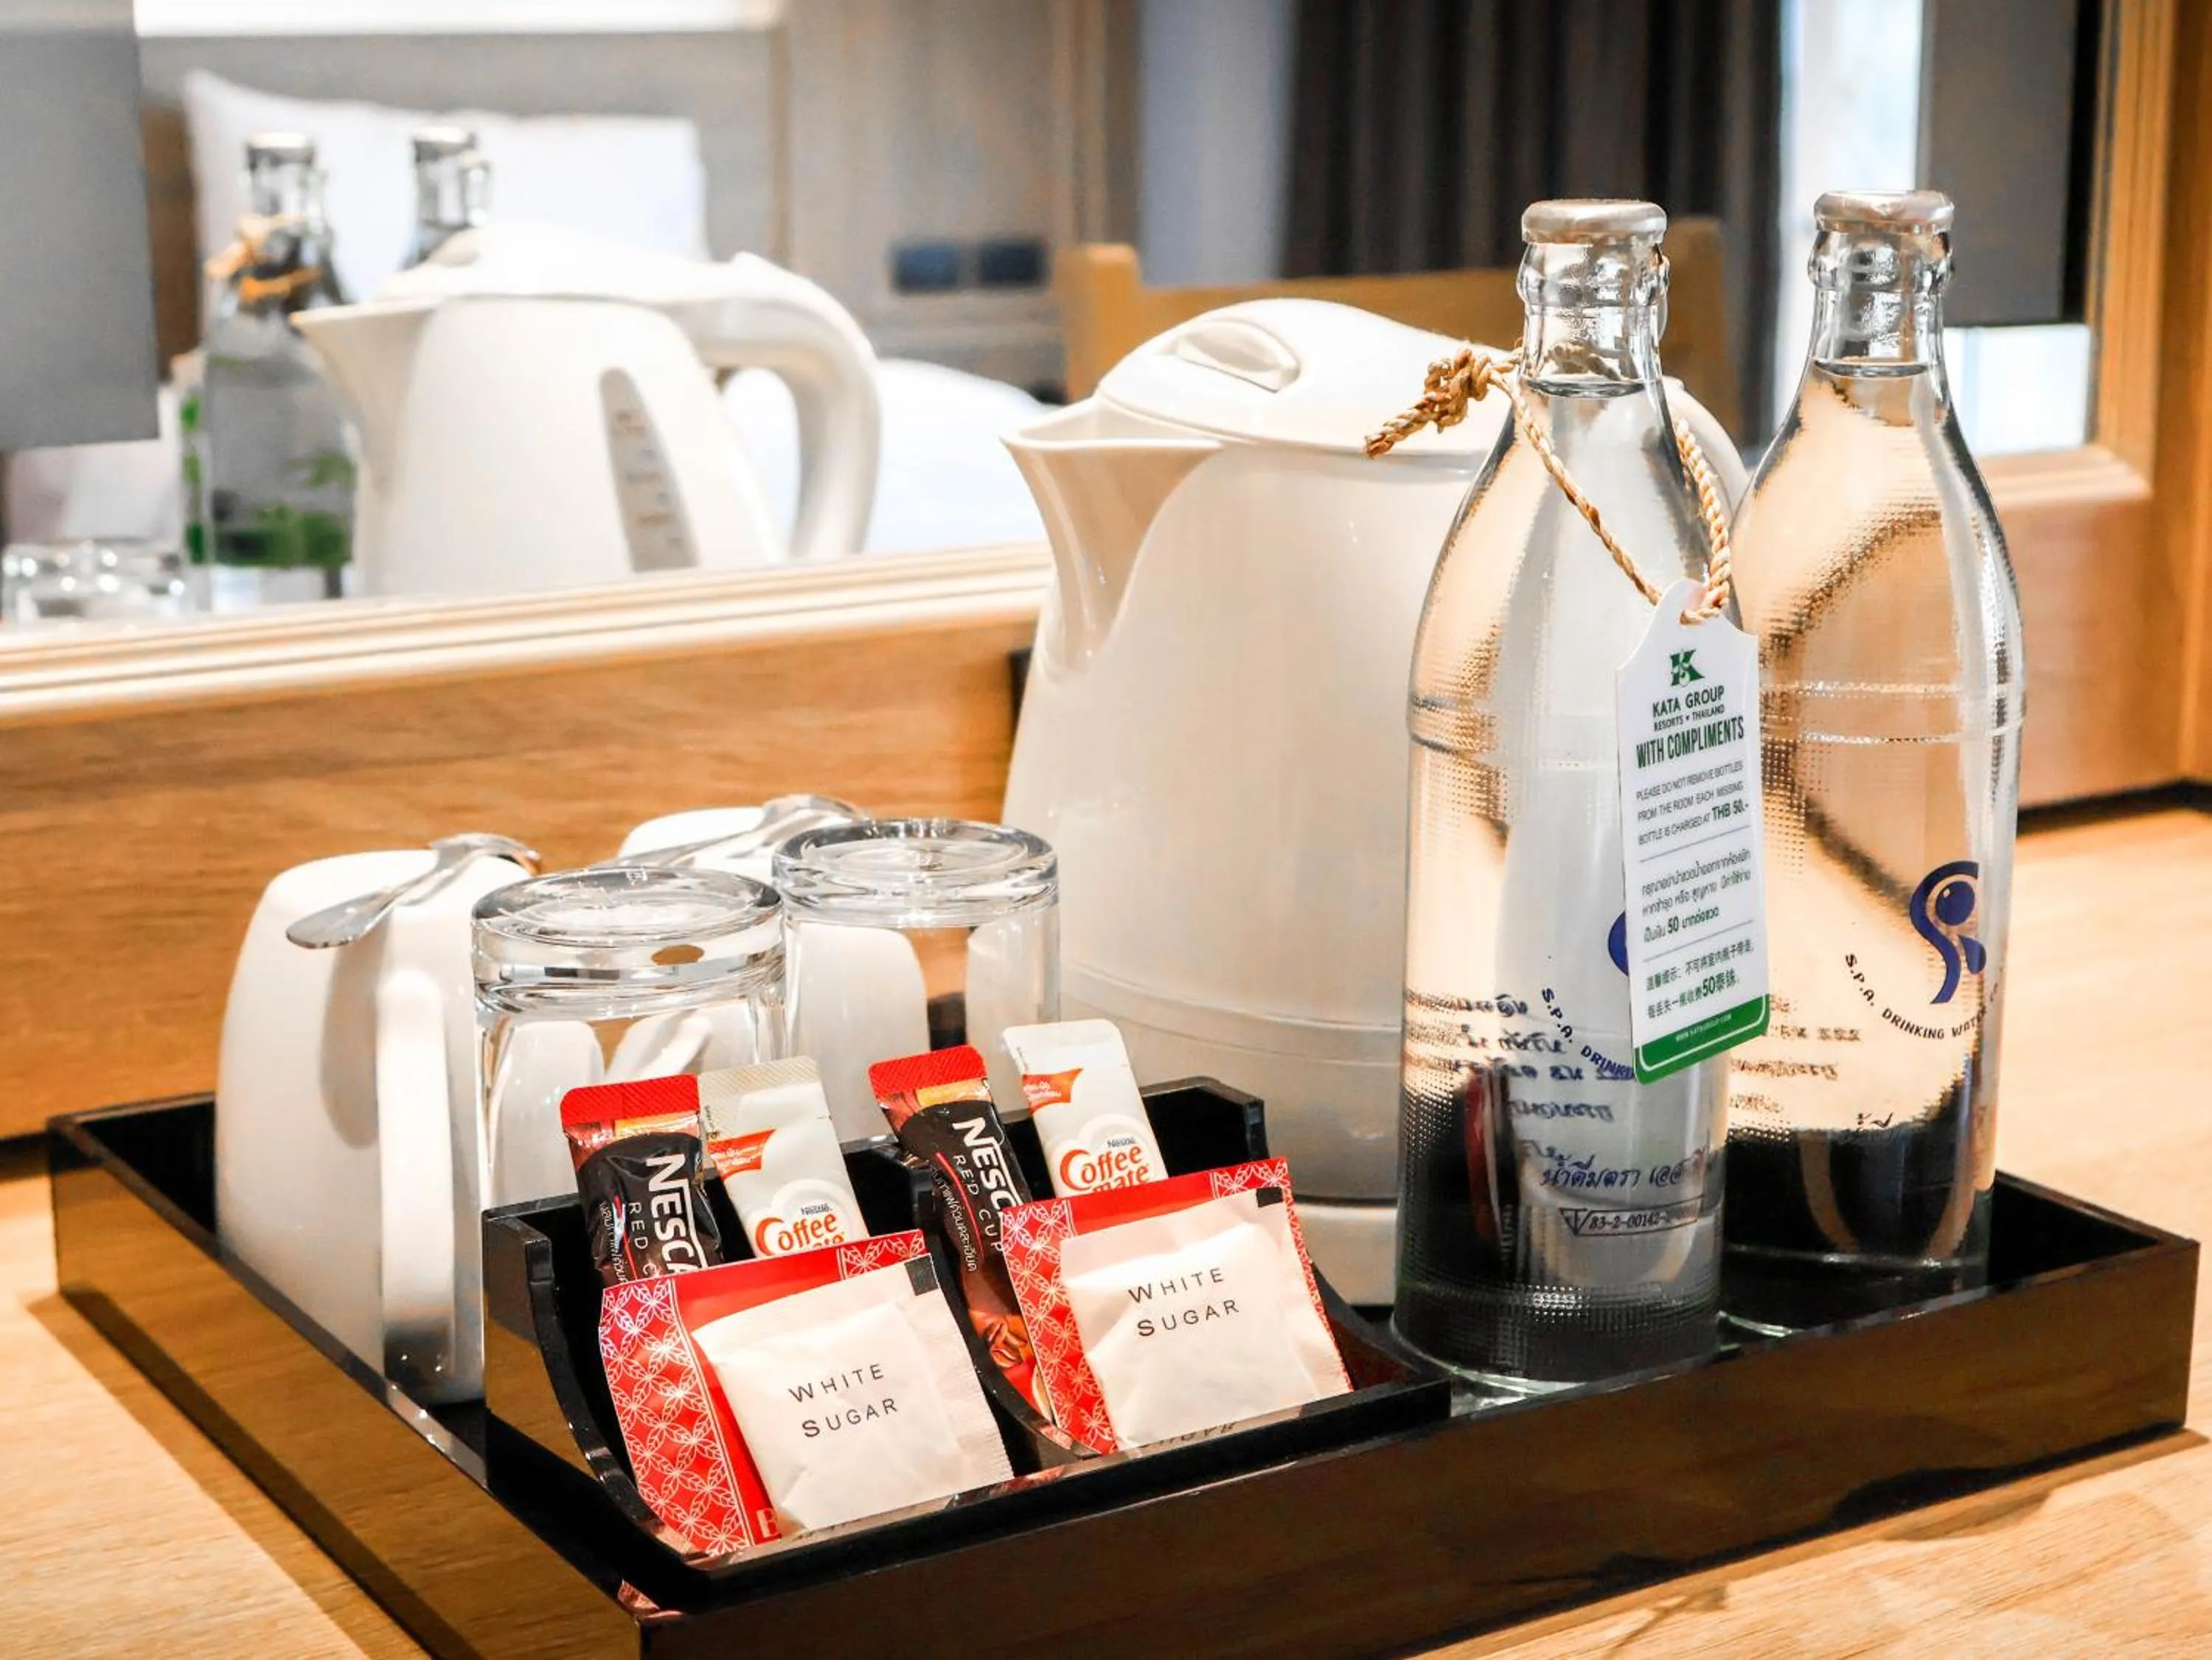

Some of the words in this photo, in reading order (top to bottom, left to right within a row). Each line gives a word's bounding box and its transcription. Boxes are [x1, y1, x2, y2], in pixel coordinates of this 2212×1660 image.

[1652, 697, 1681, 718] KATA
[1685, 685, 1725, 708] GROUP
[1654, 715, 1683, 731] RESORTS
[1692, 704, 1725, 720] THAILAND
[1636, 738, 1664, 768] WITH
[1667, 716, 1744, 759] COMPLIMENTS
[1636, 785, 1661, 801] PLEASE
[1662, 781, 1672, 794] DO
[1673, 776, 1686, 789] NOT
[1686, 769, 1714, 785] REMOVE
[1715, 760, 1744, 778] BOTTLES
[1638, 806, 1657, 821] FROM
[1659, 801, 1672, 815] THE
[1696, 789, 1714, 804] EACH
[1716, 780, 1744, 798] MISSING
[1638, 828, 1663, 845] BOTTLE
[1664, 825, 1671, 837] IS
[1672, 815, 1703, 834] CHARGED
[1703, 812, 1711, 824] AT
[1711, 803, 1731, 820] THB
[1667, 916, 1680, 934] 50
[1542, 988, 1573, 1043] S.P.A.
[1846, 953, 1875, 1007] S.P.A.
[1881, 1007, 1945, 1039] DRINKING
[952, 1117, 1023, 1213] NESC
[1060, 1145, 1142, 1191] Coffee
[953, 1154, 979, 1196] RED
[978, 1208, 1004, 1252] CUP
[628, 1202, 649, 1250] RED
[754, 1213, 838, 1257] Coffee
[1127, 1267, 1225, 1304] WHITE
[1136, 1299, 1239, 1336] SUGAR
[787, 1363, 885, 1403] WHITE
[801, 1398, 898, 1438] SUGAR
